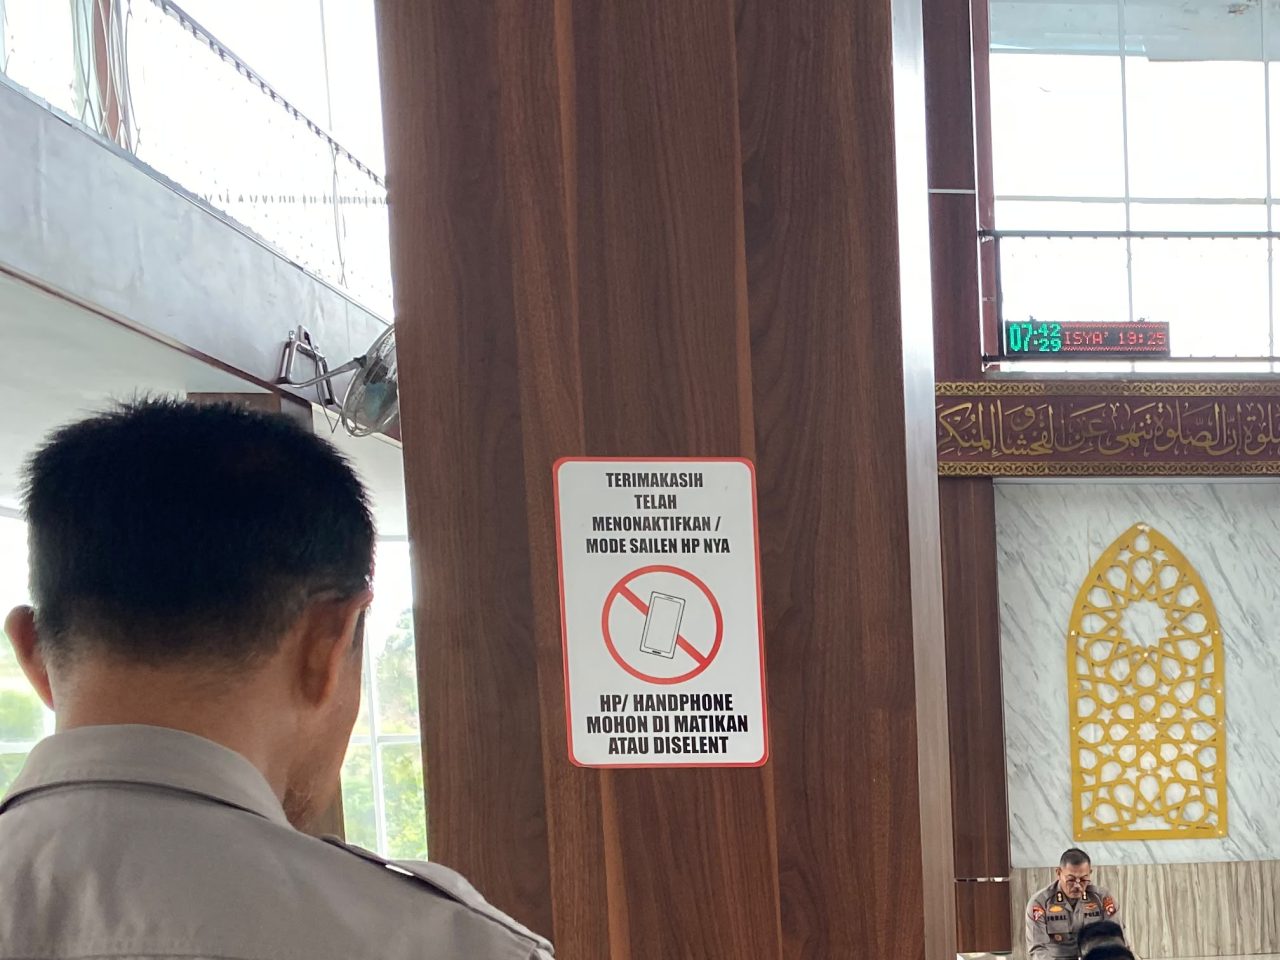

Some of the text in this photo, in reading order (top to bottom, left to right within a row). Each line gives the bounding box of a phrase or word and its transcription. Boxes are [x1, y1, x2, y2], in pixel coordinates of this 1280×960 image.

[1119, 331, 1166, 345] 19:25
[606, 473, 703, 487] TERIMAKASIH
[634, 495, 676, 509] TELAH
[593, 517, 720, 531] MENONAKTIFKAN /
[587, 538, 730, 553] MODE SAILEN HP NYA
[600, 694, 733, 712] HP/ HANDPHONE
[587, 715, 748, 733] MOHON DI MATIKAN
[609, 737, 728, 754] ATAU DISELENT
